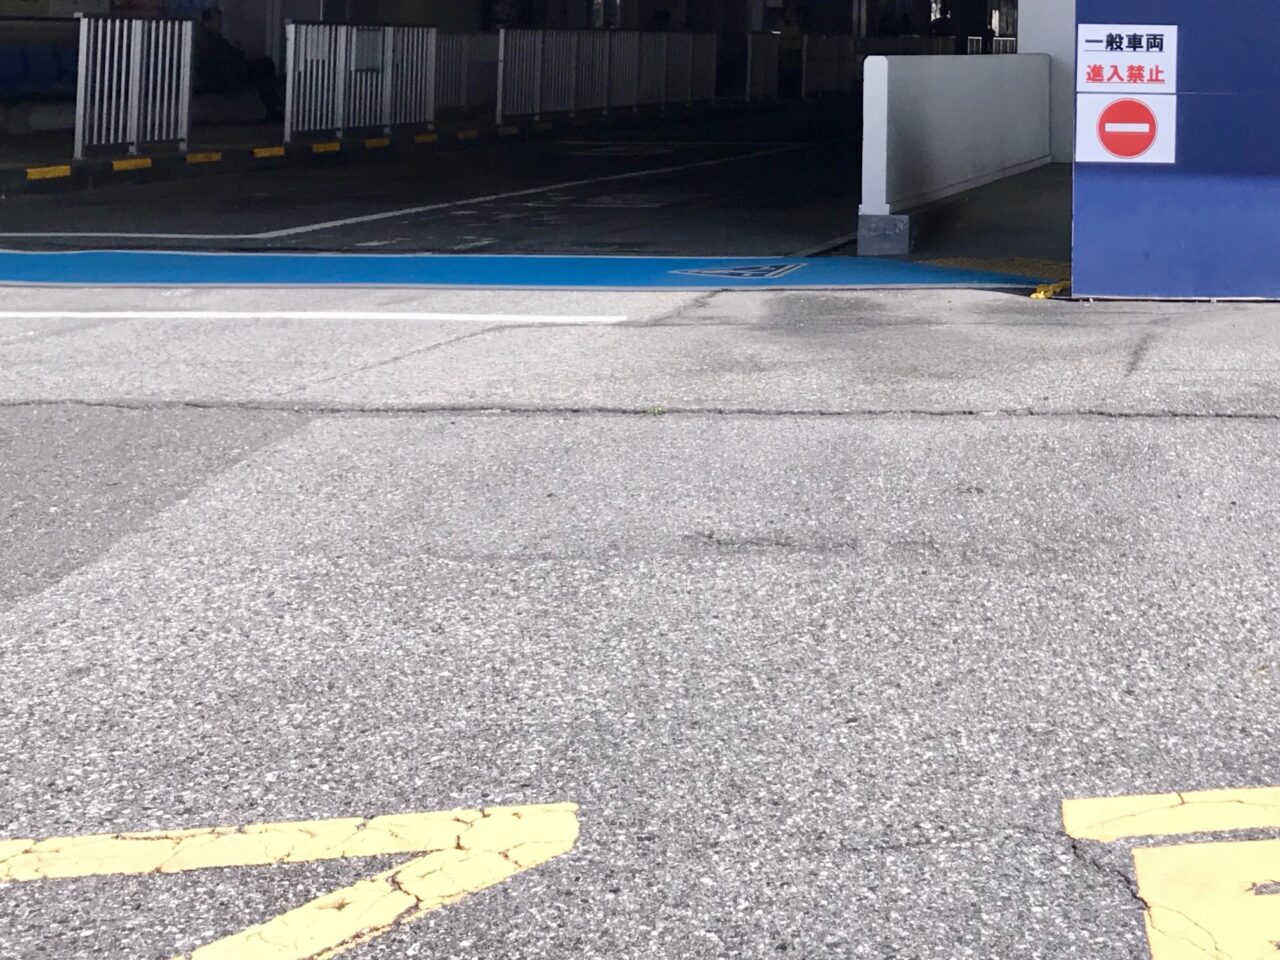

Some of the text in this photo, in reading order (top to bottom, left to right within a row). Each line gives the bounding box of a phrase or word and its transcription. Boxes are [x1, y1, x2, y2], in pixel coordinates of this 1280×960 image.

[1085, 32, 1165, 52] 一般車両
[1086, 64, 1165, 83] 進入禁止
